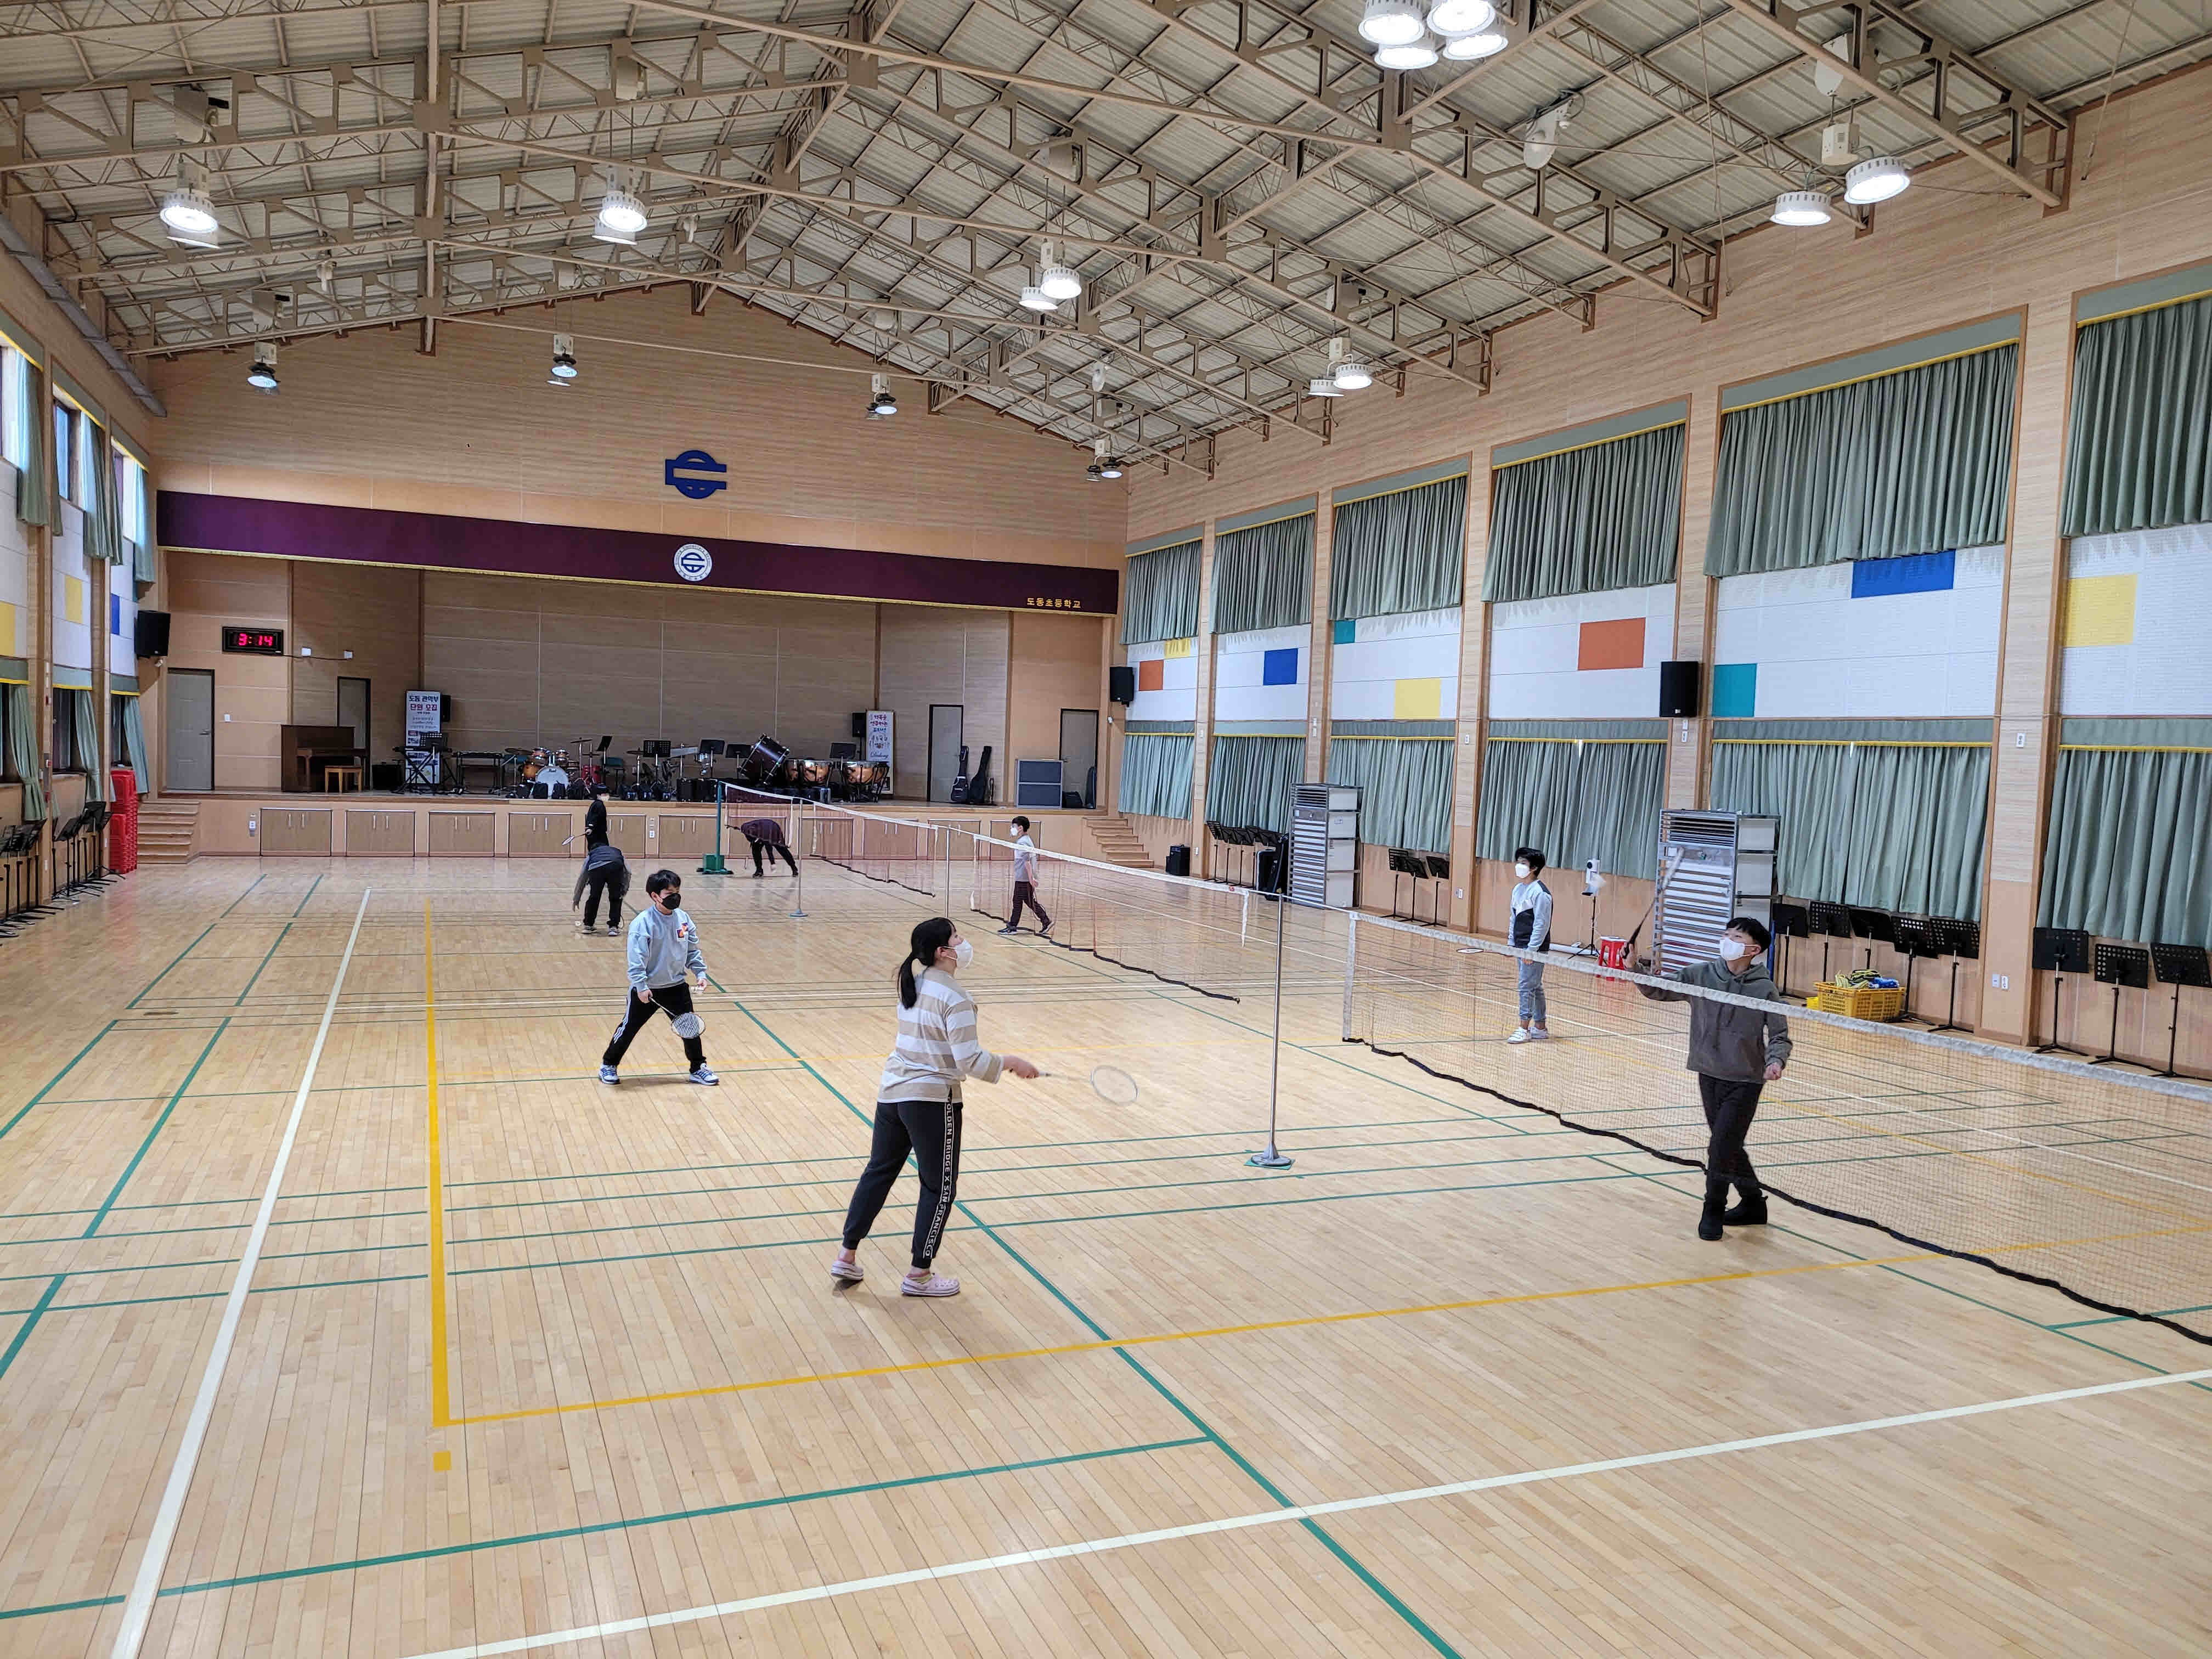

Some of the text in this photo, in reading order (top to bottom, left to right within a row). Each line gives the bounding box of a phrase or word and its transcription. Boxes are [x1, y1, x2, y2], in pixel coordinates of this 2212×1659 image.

[1026, 597, 1081, 608] 도동초등학교
[238, 633, 273, 646] 3:14
[942, 1186, 950, 1203] SAN
[925, 1204, 944, 1257] FRANCISCO
